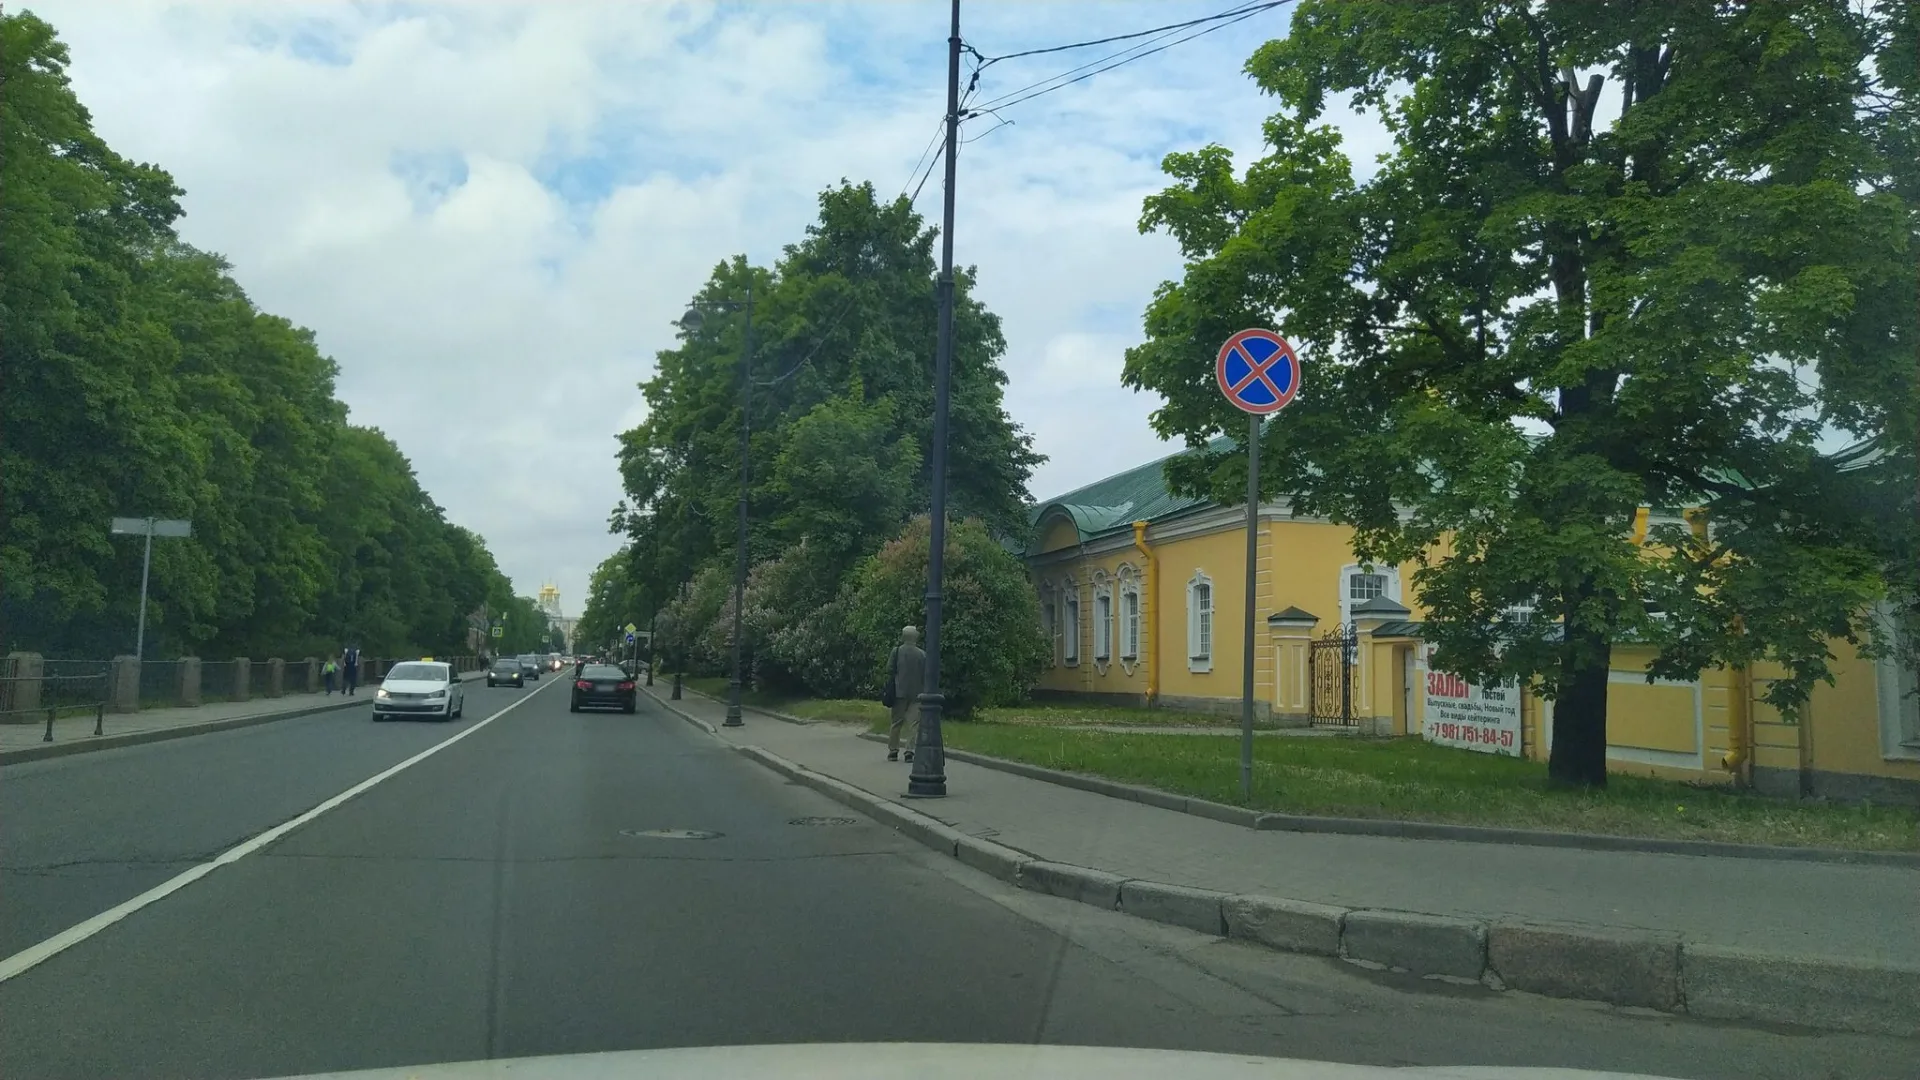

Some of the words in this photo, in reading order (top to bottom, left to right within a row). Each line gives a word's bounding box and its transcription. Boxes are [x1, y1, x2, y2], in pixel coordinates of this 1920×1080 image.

[1427, 672, 1469, 698] ЗАЛЫ
[1427, 698, 1457, 710] Выпускные,
[1458, 702, 1483, 713] свадьбы,
[1484, 703, 1504, 713] Новый
[1505, 706, 1516, 717] год
[1440, 709, 1450, 719] Все
[1451, 712, 1466, 721] виды
[1467, 713, 1500, 725] кейтеринга
[1428, 722, 1440, 737] +7
[1442, 723, 1459, 740] 981
[1462, 725, 1513, 747] 751-84-57
